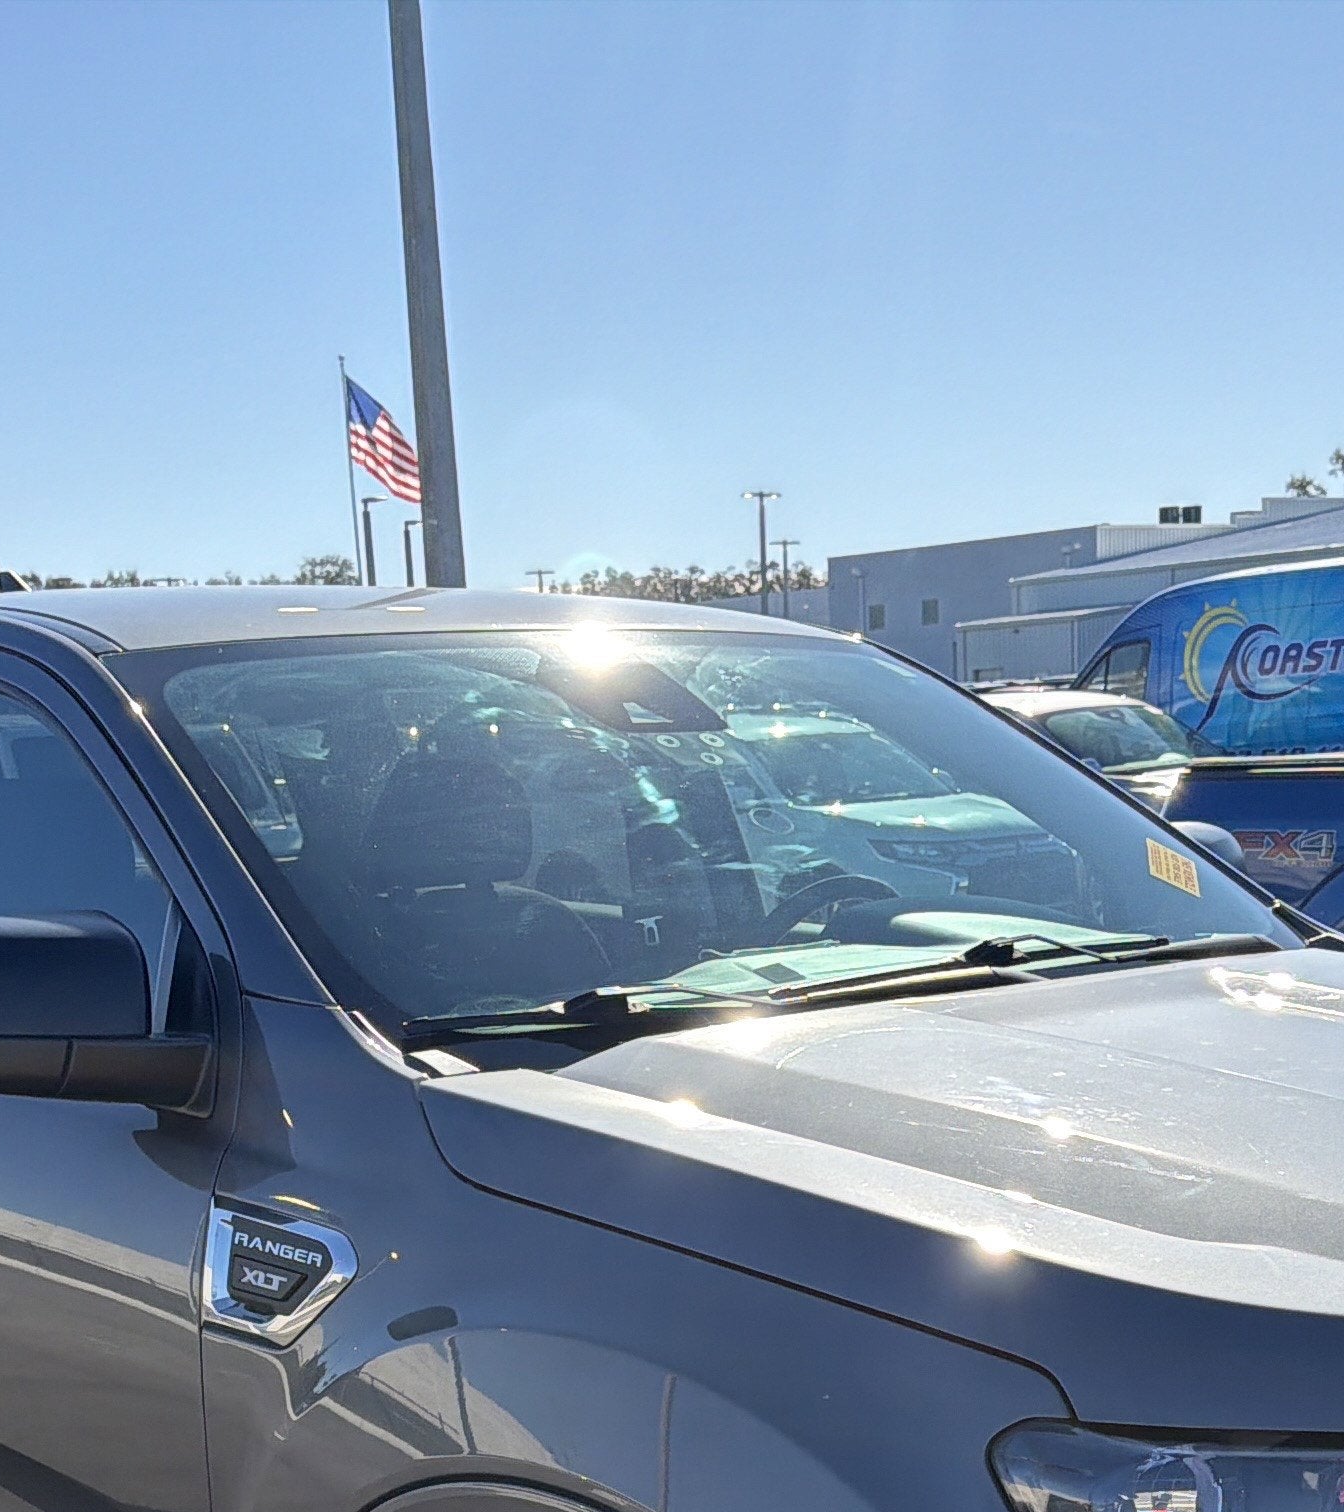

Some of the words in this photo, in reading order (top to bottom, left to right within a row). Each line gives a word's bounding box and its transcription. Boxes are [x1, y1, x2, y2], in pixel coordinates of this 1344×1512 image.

[1233, 829, 1337, 861] FX4
[234, 1232, 323, 1268] RANGER
[241, 1265, 288, 1292] XLT
